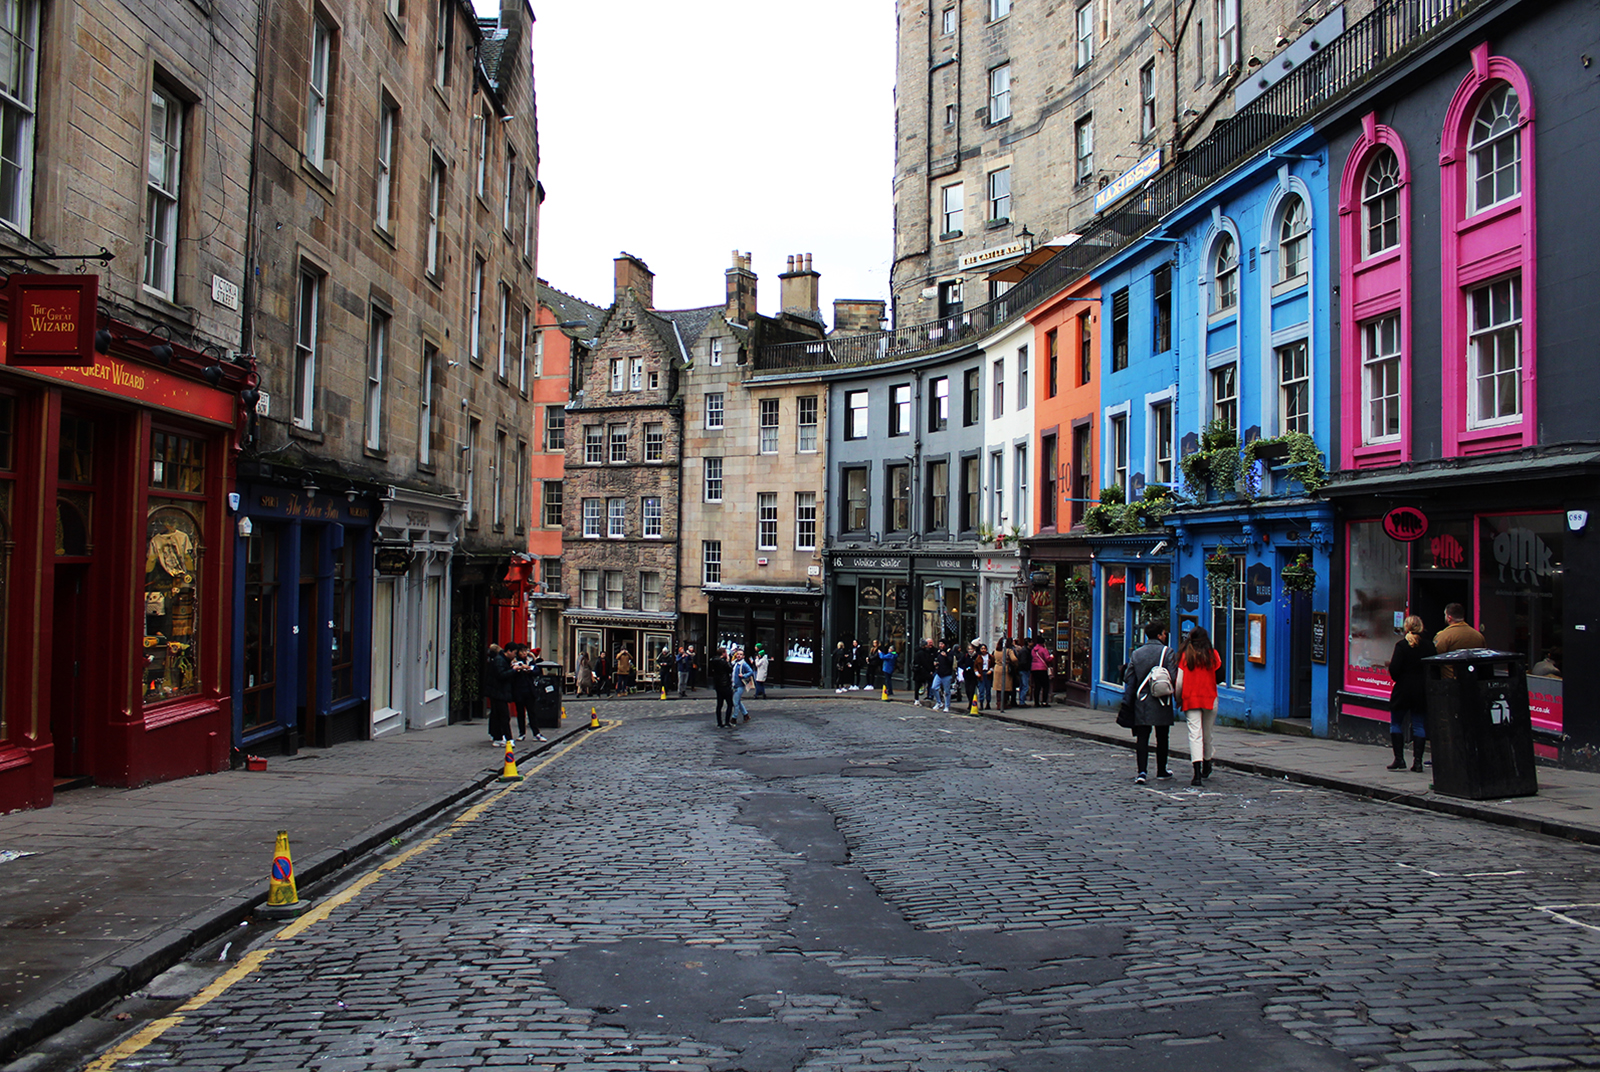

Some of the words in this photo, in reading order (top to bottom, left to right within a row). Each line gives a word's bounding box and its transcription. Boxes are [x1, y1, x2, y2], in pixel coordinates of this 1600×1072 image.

[963, 256, 977, 265] THE
[978, 248, 1005, 261] CASTLE
[214, 276, 237, 297] VICTORIA
[216, 289, 235, 307] STREET
[30, 303, 47, 316] THE
[46, 307, 73, 321] GREAT
[29, 316, 76, 332] WIZARD
[110, 360, 145, 391] WIZARD
[1568, 513, 1583, 522] CSS
[853, 558, 877, 567] Walker
[880, 557, 902, 568] Slater
